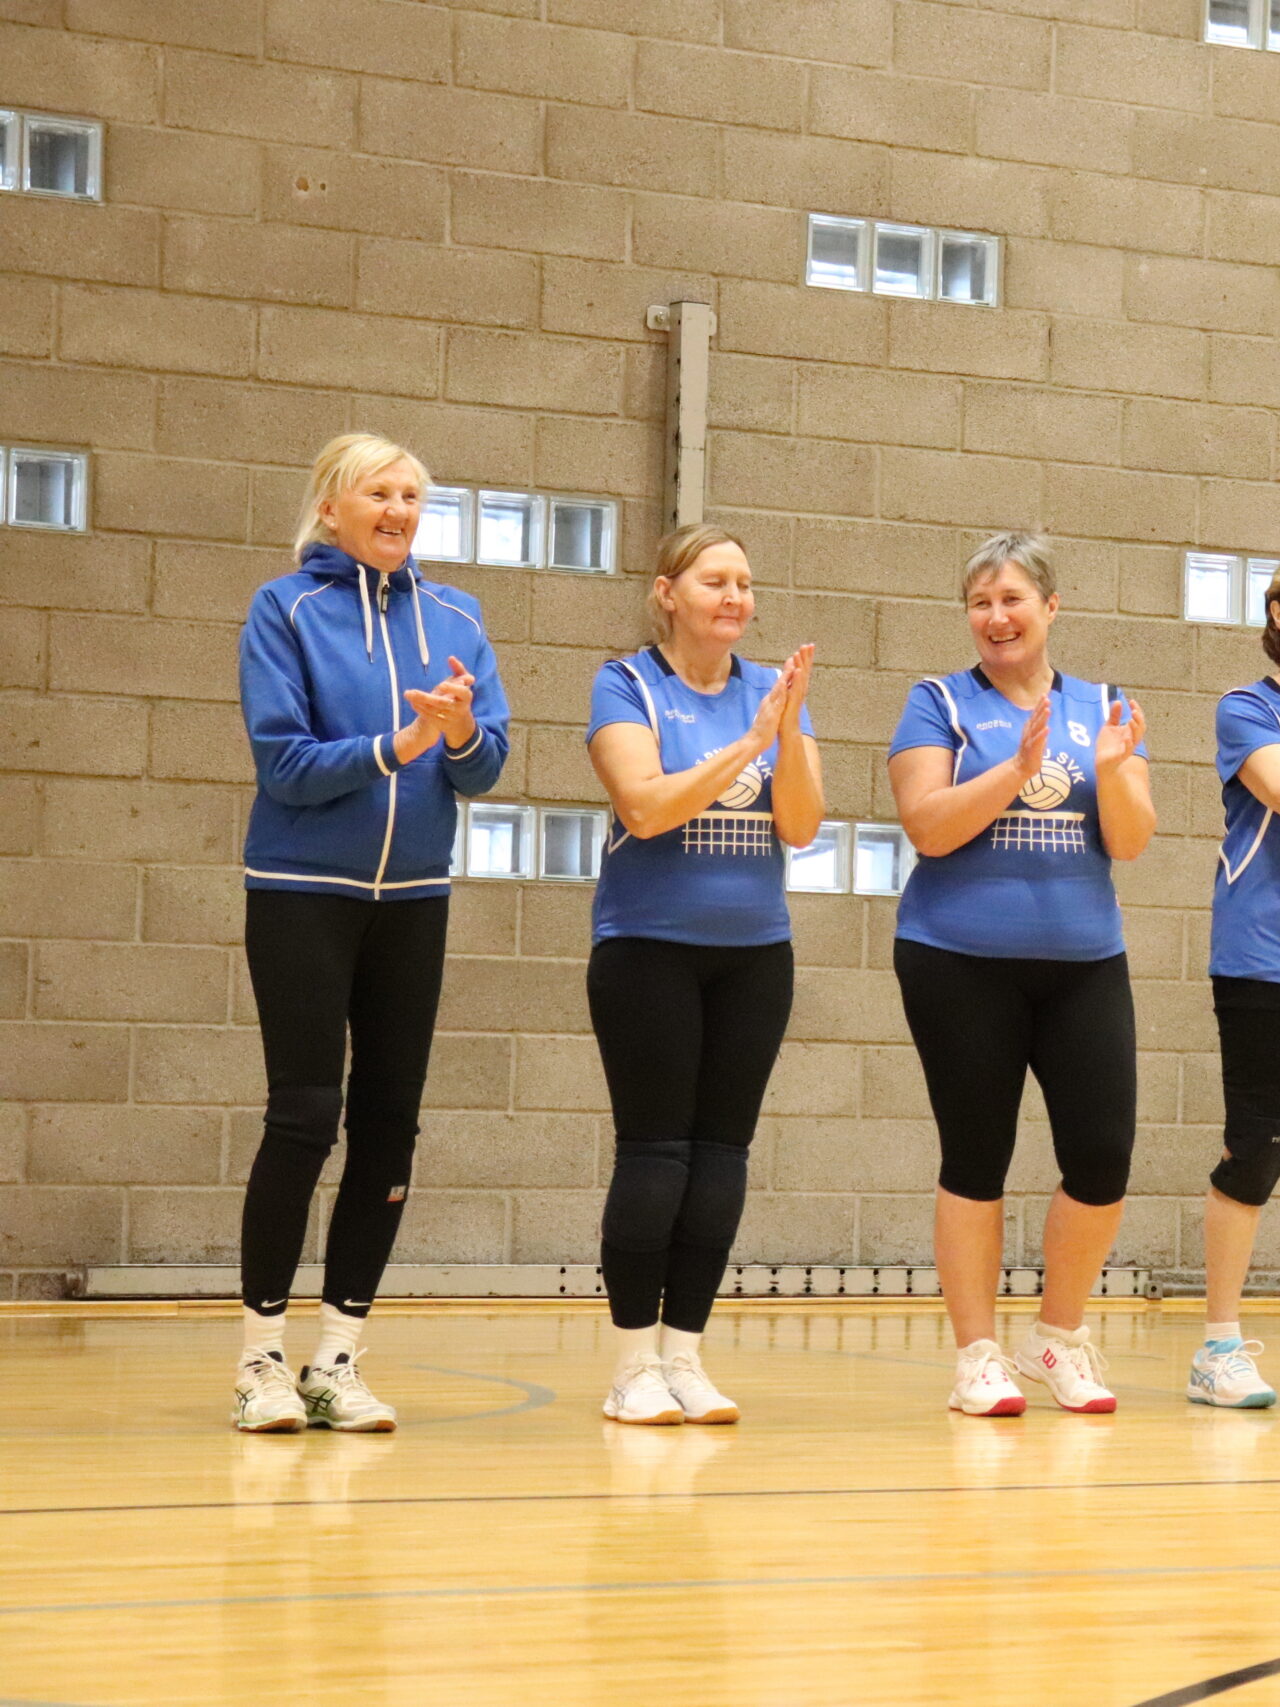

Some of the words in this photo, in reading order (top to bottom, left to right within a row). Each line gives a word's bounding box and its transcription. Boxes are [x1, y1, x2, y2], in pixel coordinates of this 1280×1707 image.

[1067, 720, 1091, 747] 8
[756, 754, 773, 780] VK
[1056, 751, 1086, 784] SVK
